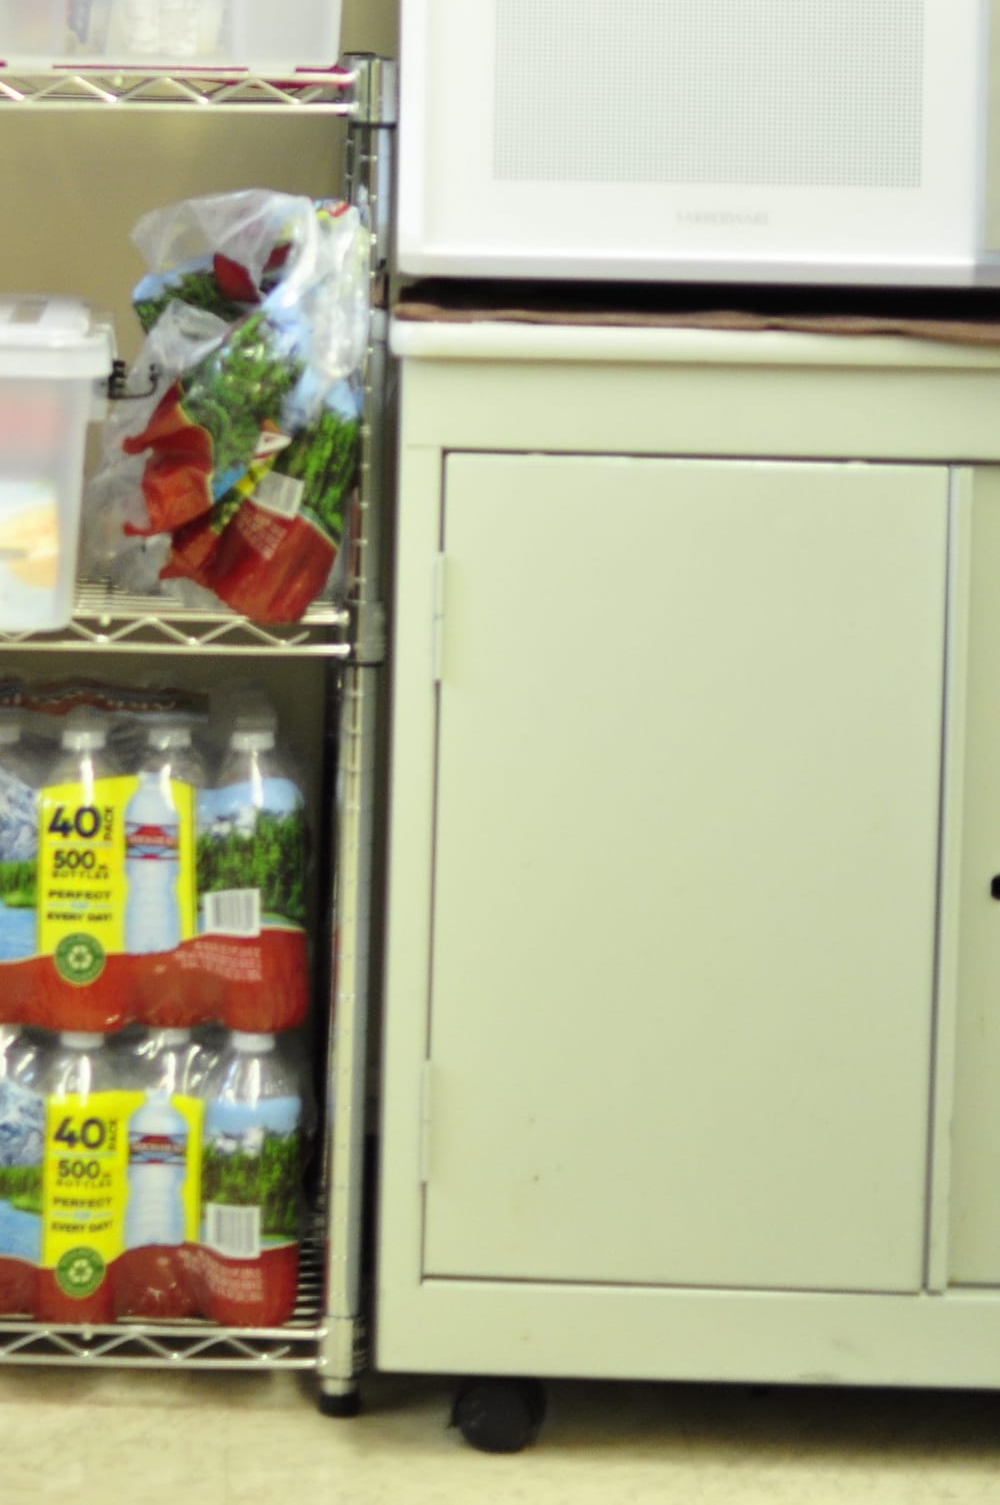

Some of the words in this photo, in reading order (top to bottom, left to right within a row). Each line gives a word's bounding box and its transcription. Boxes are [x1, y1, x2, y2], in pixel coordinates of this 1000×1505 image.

[48, 805, 101, 839] 40
[54, 850, 96, 870] 500
[48, 889, 111, 900] PERFECT
[54, 1116, 106, 1150] 40
[58, 1159, 100, 1179] 500
[53, 1196, 112, 1207] PERFECT
